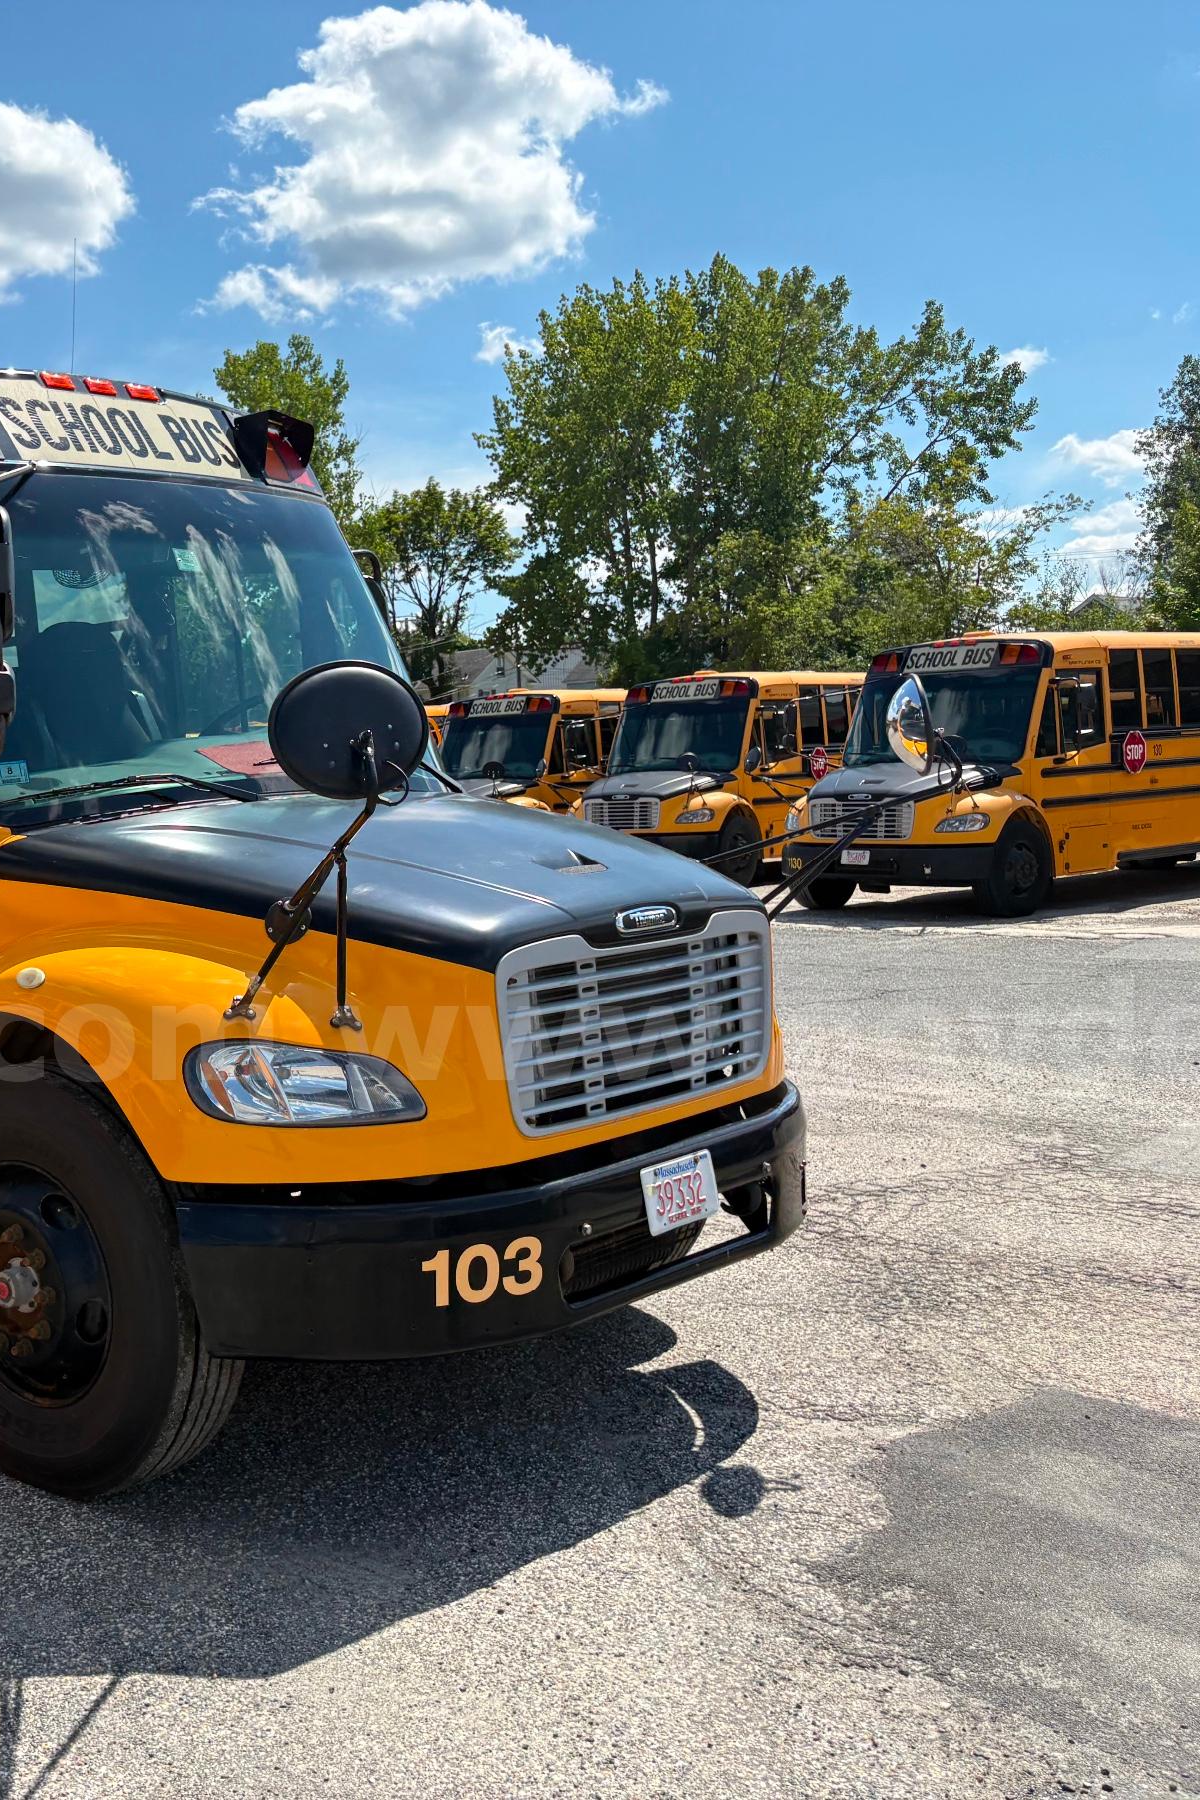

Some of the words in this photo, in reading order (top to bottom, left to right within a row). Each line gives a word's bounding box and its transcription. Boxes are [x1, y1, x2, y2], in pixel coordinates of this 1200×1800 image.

[157, 414, 241, 469] BUS
[907, 650, 958, 669] SCHOOL
[961, 648, 994, 665] BUS
[653, 685, 691, 699] SCHOOL
[693, 683, 716, 697] BUS
[470, 701, 502, 714] SCHOOL
[504, 700, 525, 712] BUS
[1126, 744, 1144, 760] STOP
[657, 1160, 696, 1178] Massachusetts
[656, 1170, 706, 1216] 39332
[421, 1236, 543, 1307] 103
